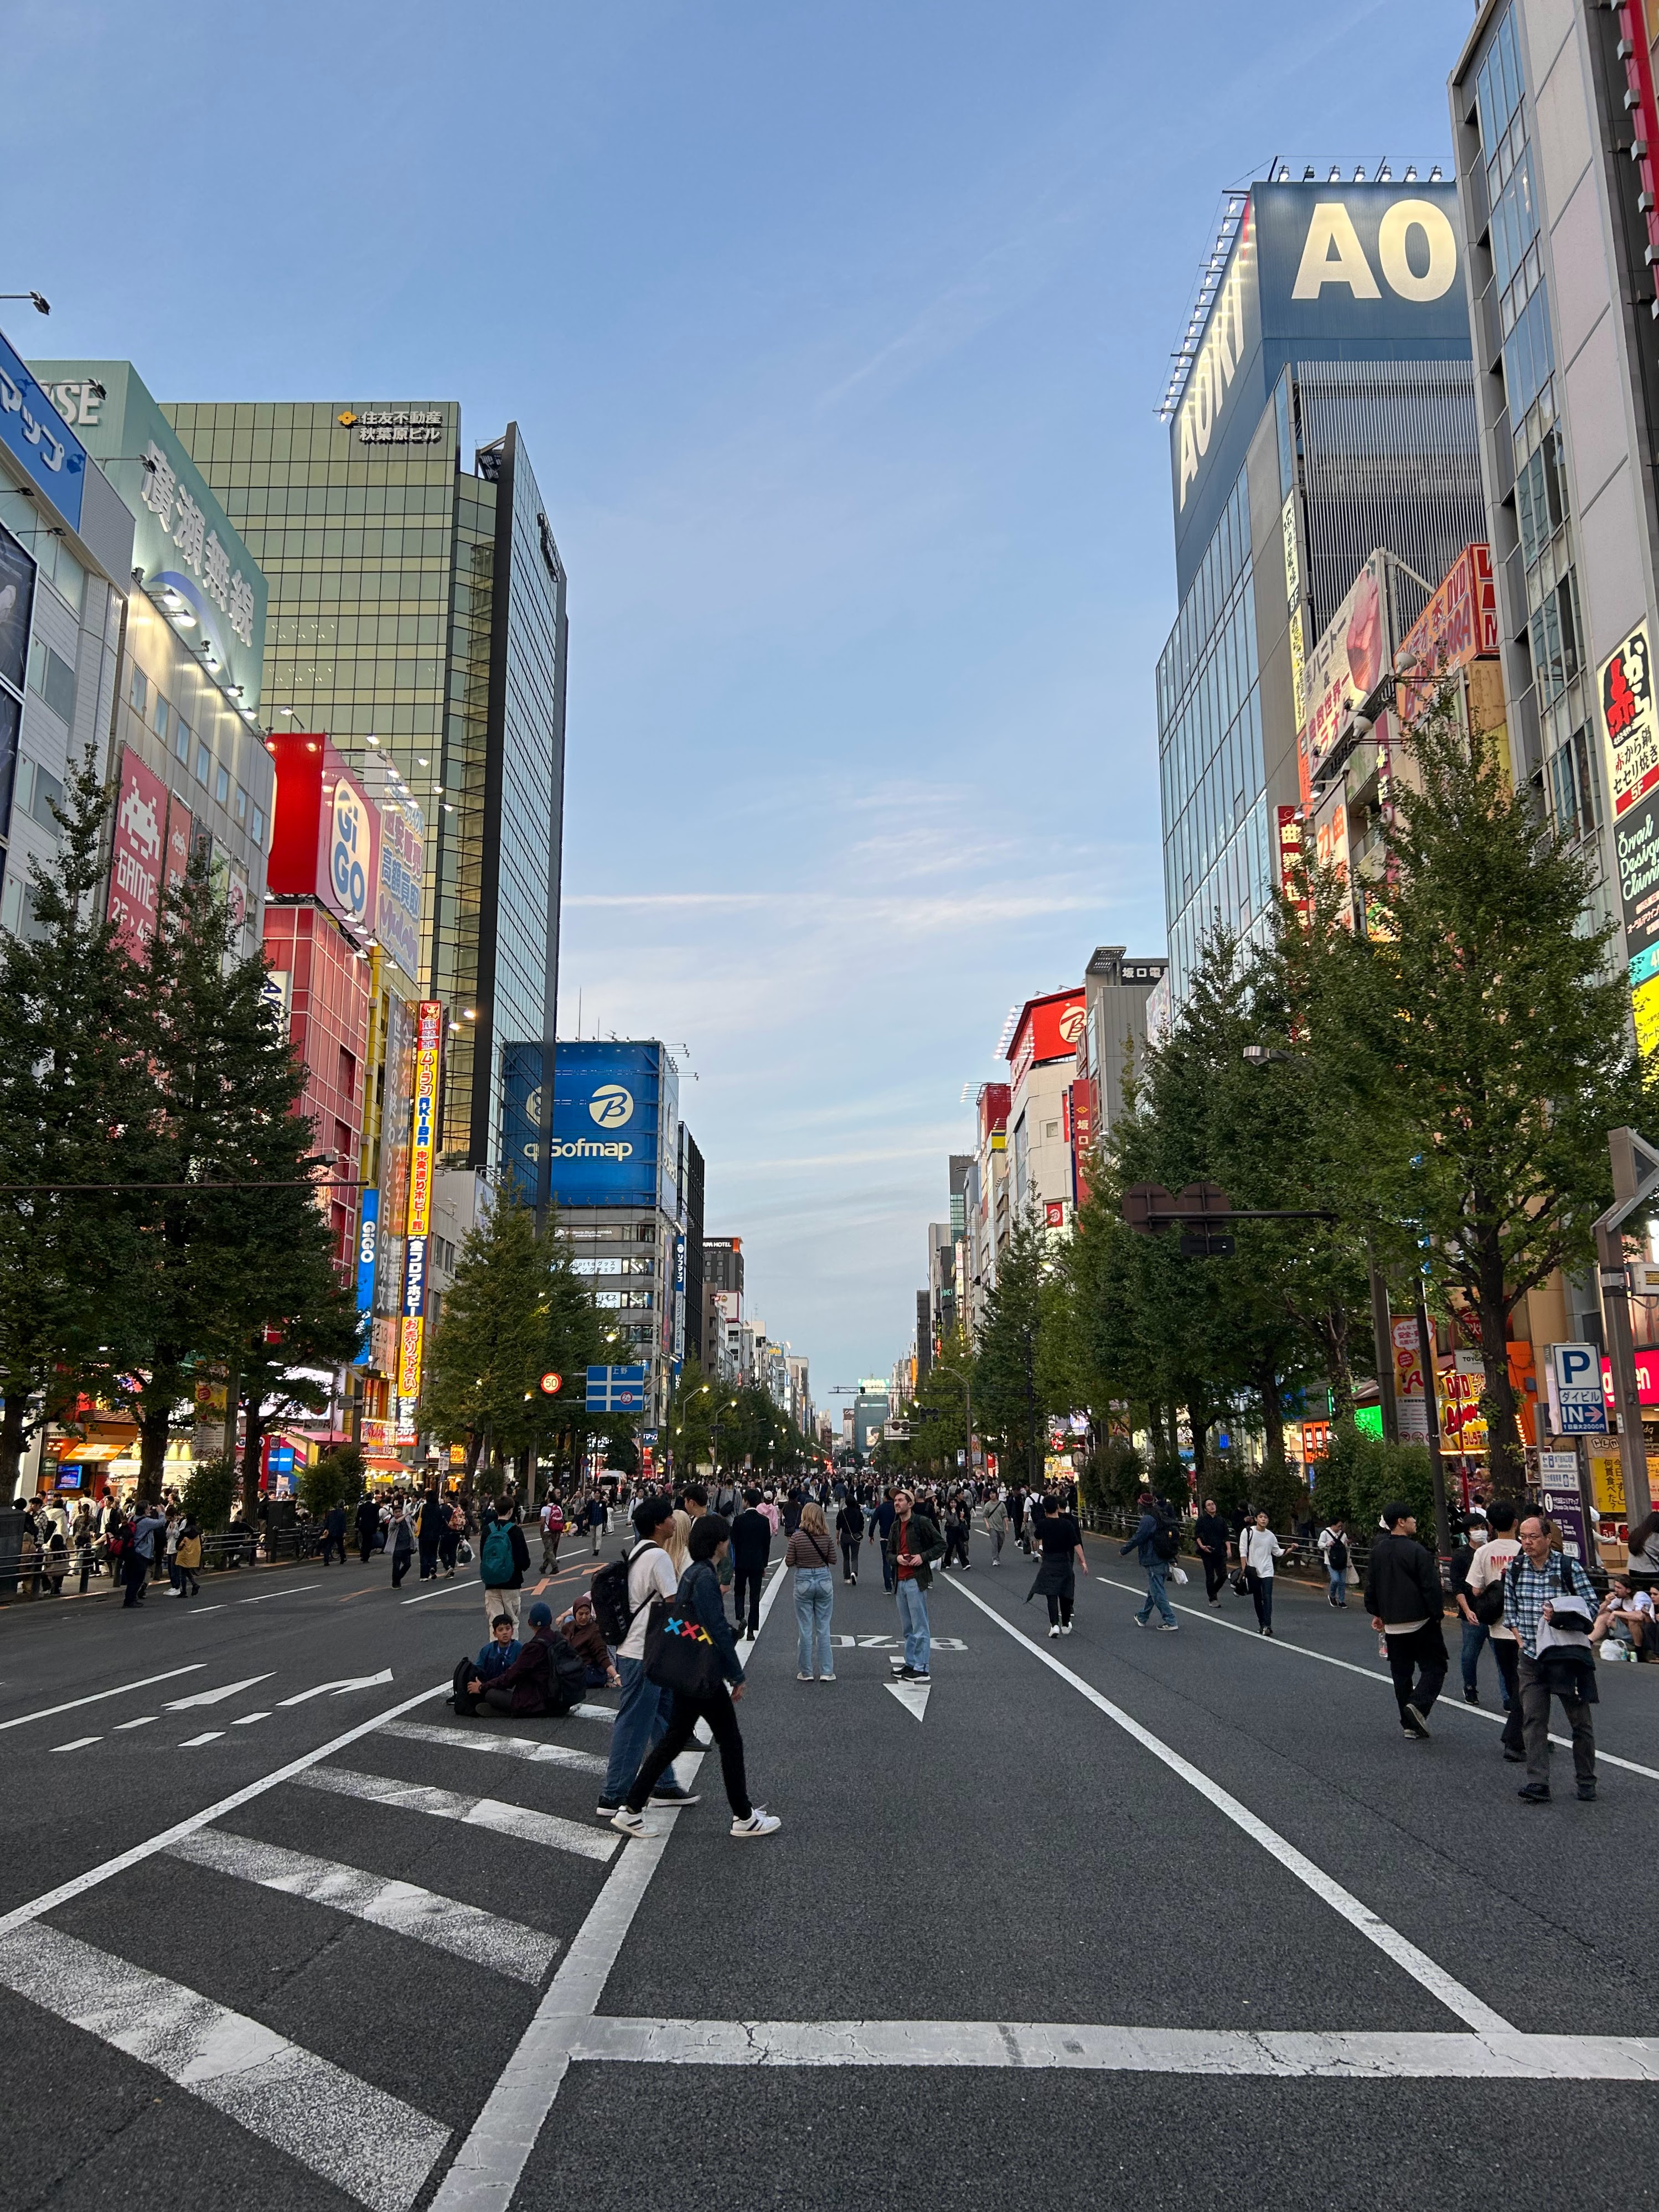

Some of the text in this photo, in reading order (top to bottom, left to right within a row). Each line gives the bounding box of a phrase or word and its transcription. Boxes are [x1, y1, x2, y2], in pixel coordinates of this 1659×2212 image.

[1180, 249, 1244, 514] AOKI
[359, 427, 440, 441] 秋葉原ビル
[361, 411, 441, 424] 住友不動産
[1615, 725, 1652, 775] 赤から鍋
[1613, 744, 1658, 795] セセリ焼き
[1631, 779, 1644, 801] 5F
[117, 847, 156, 913] GAME
[417, 1097, 431, 1147] AKIBA
[551, 1138, 633, 1162] Sofmap
[411, 1151, 428, 1232] 中央通りホビー館
[360, 1220, 376, 1263] GiGO
[407, 1241, 423, 1317] 全フロアホビー
[545, 1378, 557, 1388] 50
[1562, 1351, 1590, 1384] P
[1562, 1391, 1600, 1403] ダイビル
[1562, 1406, 1584, 1423] IN
